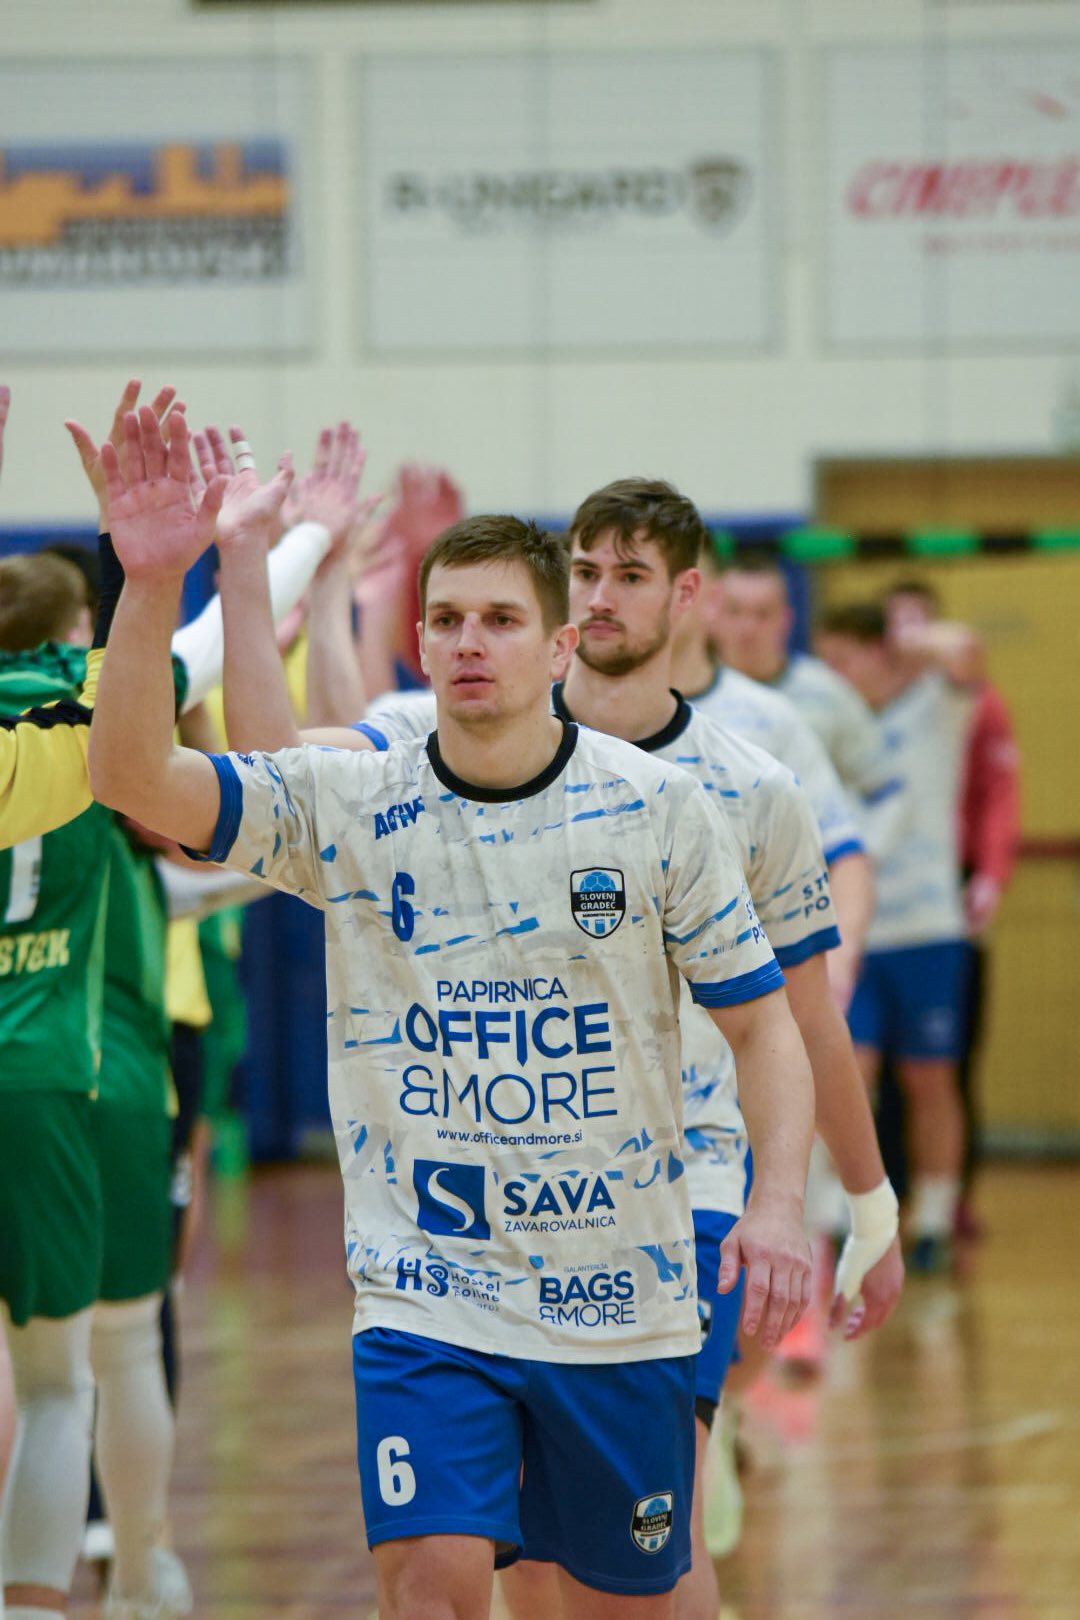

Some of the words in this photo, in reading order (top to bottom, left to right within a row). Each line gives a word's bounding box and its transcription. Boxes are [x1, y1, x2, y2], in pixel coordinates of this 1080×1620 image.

[392, 872, 416, 942] 6
[580, 892, 616, 902] SLOVENJ
[580, 901, 616, 911] GRADEC
[436, 977, 568, 1003] PAPIRNICA
[405, 1002, 612, 1067] OFFICE
[400, 1064, 618, 1125] &MORE
[437, 1129, 583, 1146] www.officeandmore.si
[503, 1175, 616, 1217] SAVA
[504, 1216, 616, 1233] ZAVAROVALNICA
[539, 1270, 634, 1305] BAGS
[377, 1436, 416, 1506] 6
